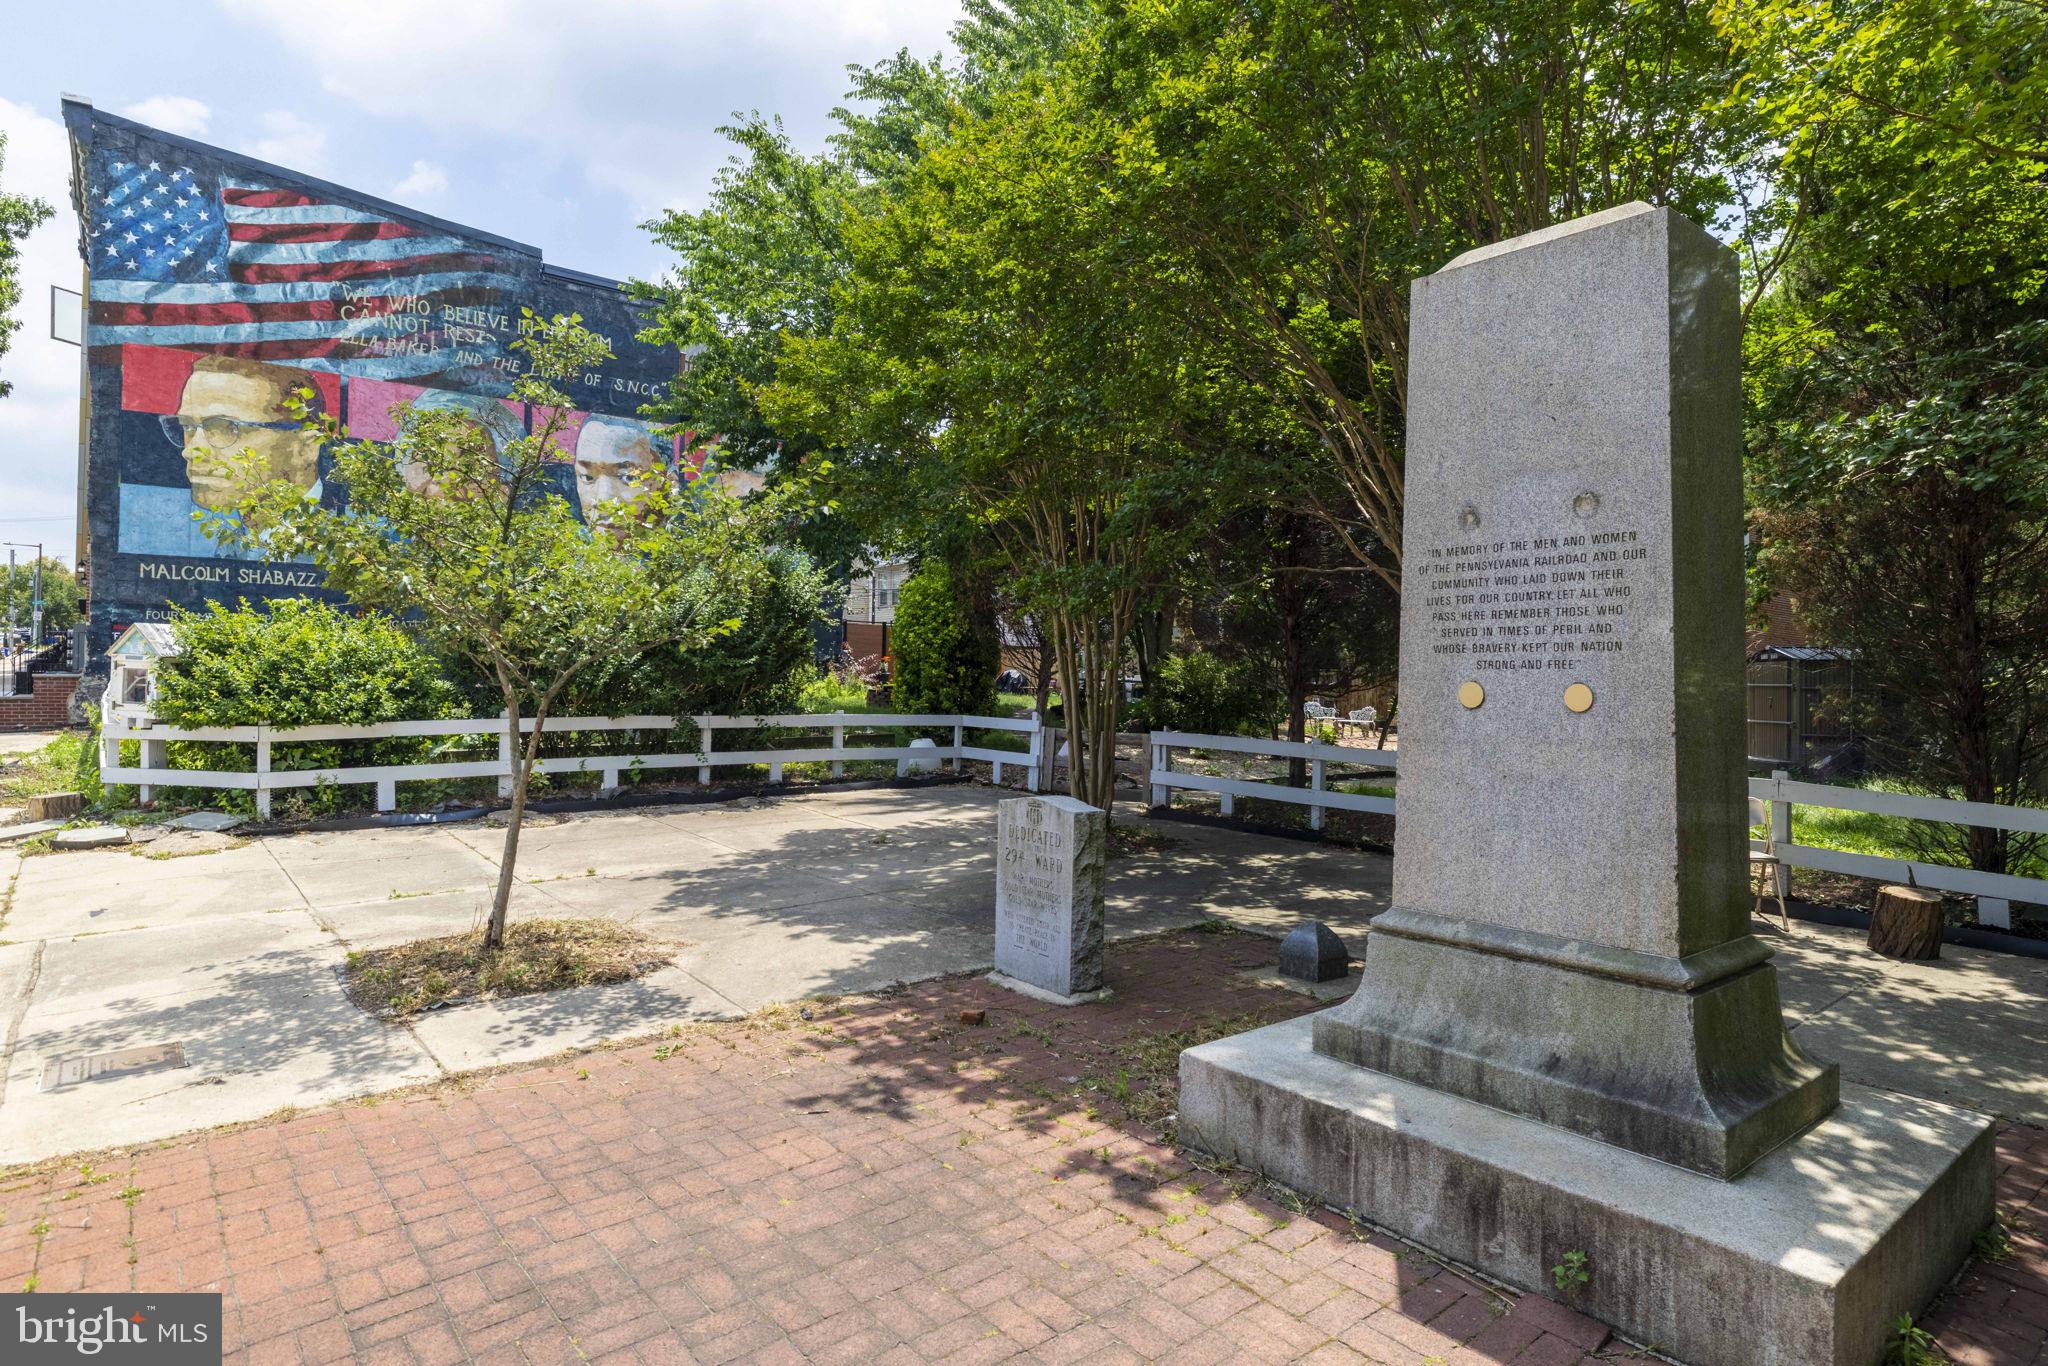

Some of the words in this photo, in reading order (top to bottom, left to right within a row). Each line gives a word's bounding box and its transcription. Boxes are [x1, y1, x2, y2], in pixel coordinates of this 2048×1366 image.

[340, 305, 430, 335] CANNOT
[387, 293, 430, 315] WHO
[443, 304, 509, 332] BELIEVE
[517, 319, 534, 336] IN
[340, 334, 378, 348] ELLA
[384, 337, 440, 356] BAKER
[455, 350, 483, 366] AND
[492, 356, 521, 373] THE
[584, 373, 602, 386] OF
[1446, 545, 1488, 557] MEMORY
[1493, 543, 1505, 553] OF
[1510, 541, 1528, 551] THE
[1534, 538, 1557, 549] MEN
[1563, 535, 1585, 547] AND
[1591, 531, 1637, 544] WOMEN
[1418, 565, 1430, 575] OF
[1434, 564, 1450, 573] THE
[1456, 558, 1529, 572] PENNSYLVANIA
[1534, 553, 1587, 566] RAILROAD
[1592, 551, 1616, 562] AND
[1623, 548, 1647, 560] OUR
[139, 562, 230, 583] MALCOLM
[237, 568, 317, 587] SHABAZZ
[1432, 577, 1490, 590] COMMUNITY
[1494, 575, 1518, 586] WHO
[1523, 574, 1546, 585] LAID
[1552, 571, 1585, 583] DOWN
[1591, 568, 1624, 580] THEIR
[1426, 596, 1451, 606] LIVES
[1456, 595, 1474, 605] FOR
[1479, 593, 1499, 603] OUR
[1557, 589, 1575, 599] LET
[1580, 588, 1598, 598] ALL
[1604, 586, 1631, 597] WHO
[145, 610, 180, 621] FOUR
[1432, 612, 1456, 621] PASS
[1461, 610, 1486, 620] HERE
[1491, 608, 1550, 620] REMEMBER
[1556, 606, 1590, 617] THOSE
[1596, 605, 1623, 615] WHO
[1441, 627, 1478, 638] SERVED
[1482, 627, 1493, 636] IN
[1498, 626, 1529, 636] TIMES
[1535, 625, 1547, 635] OF
[1553, 624, 1583, 635] PERIL
[1588, 623, 1612, 634] AND
[1433, 643, 1467, 654] WHOSE
[1472, 642, 1517, 653] BRAVERY
[1522, 642, 1548, 652] KEPT
[1553, 642, 1574, 652] OUR
[1581, 641, 1623, 652] NATION
[1476, 660, 1515, 670] STRONG
[1520, 660, 1542, 669] AND
[1008, 823, 1062, 848] DEDICATED
[1035, 854, 1063, 873] WARD
